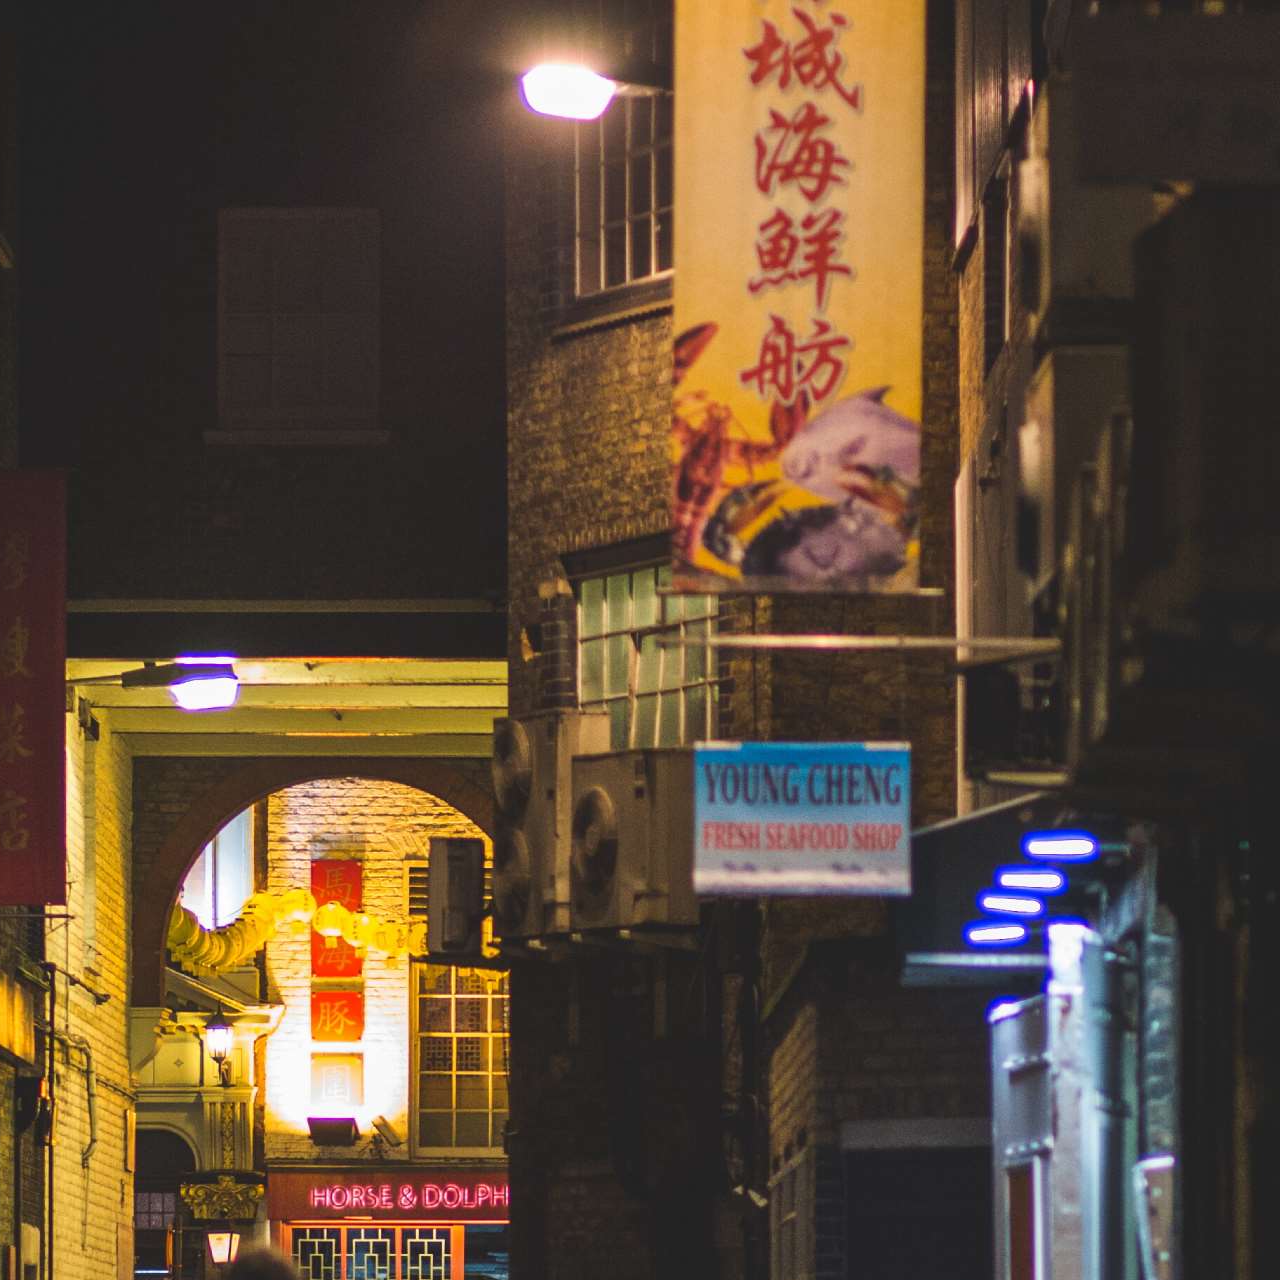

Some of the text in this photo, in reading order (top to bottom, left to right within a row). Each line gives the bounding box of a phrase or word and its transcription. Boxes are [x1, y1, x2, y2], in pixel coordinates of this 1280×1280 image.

[704, 763, 902, 806] YOUNG CHENG
[703, 822, 903, 851] FRESH SEAFOOD SHOP
[310, 1184, 393, 1209] HORSE
[399, 1184, 417, 1209] &
